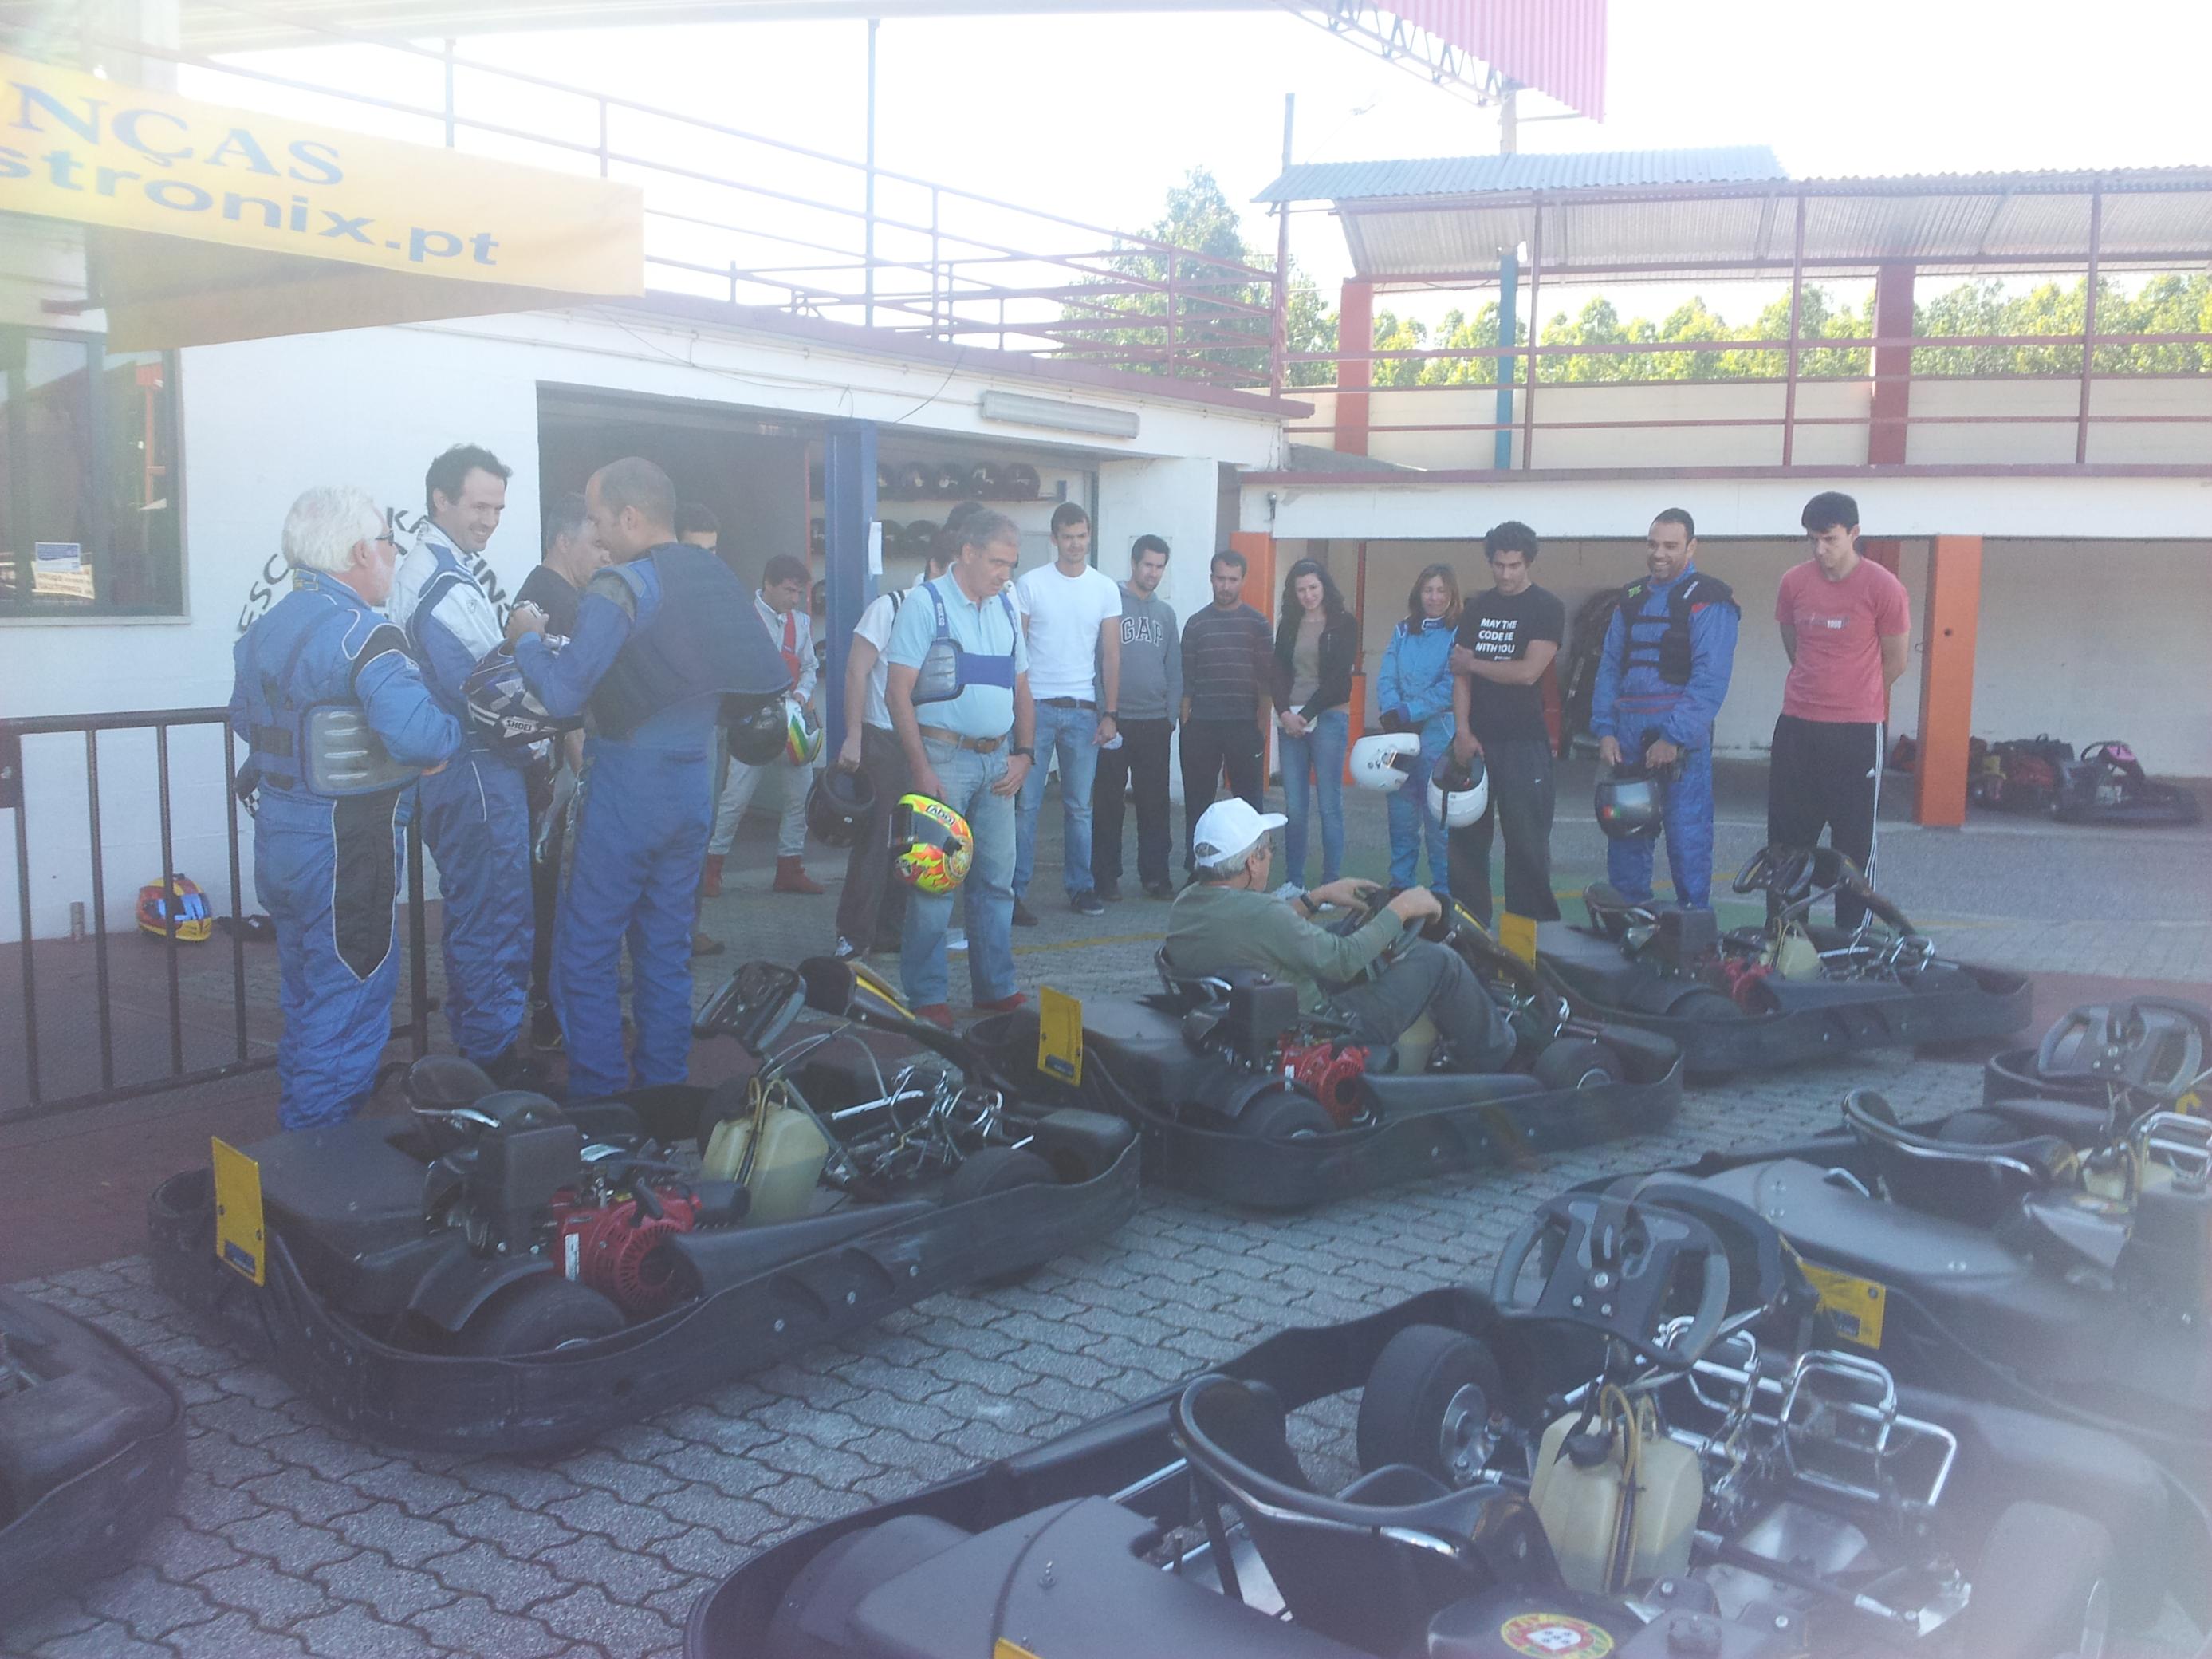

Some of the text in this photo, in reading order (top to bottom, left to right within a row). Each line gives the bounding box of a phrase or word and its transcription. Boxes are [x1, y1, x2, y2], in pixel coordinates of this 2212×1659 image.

[1480, 617, 1517, 629] MAY THE
[1120, 616, 1163, 647] GAP
[1478, 630, 1504, 641] CODE
[506, 719, 533, 731] SHOEI
